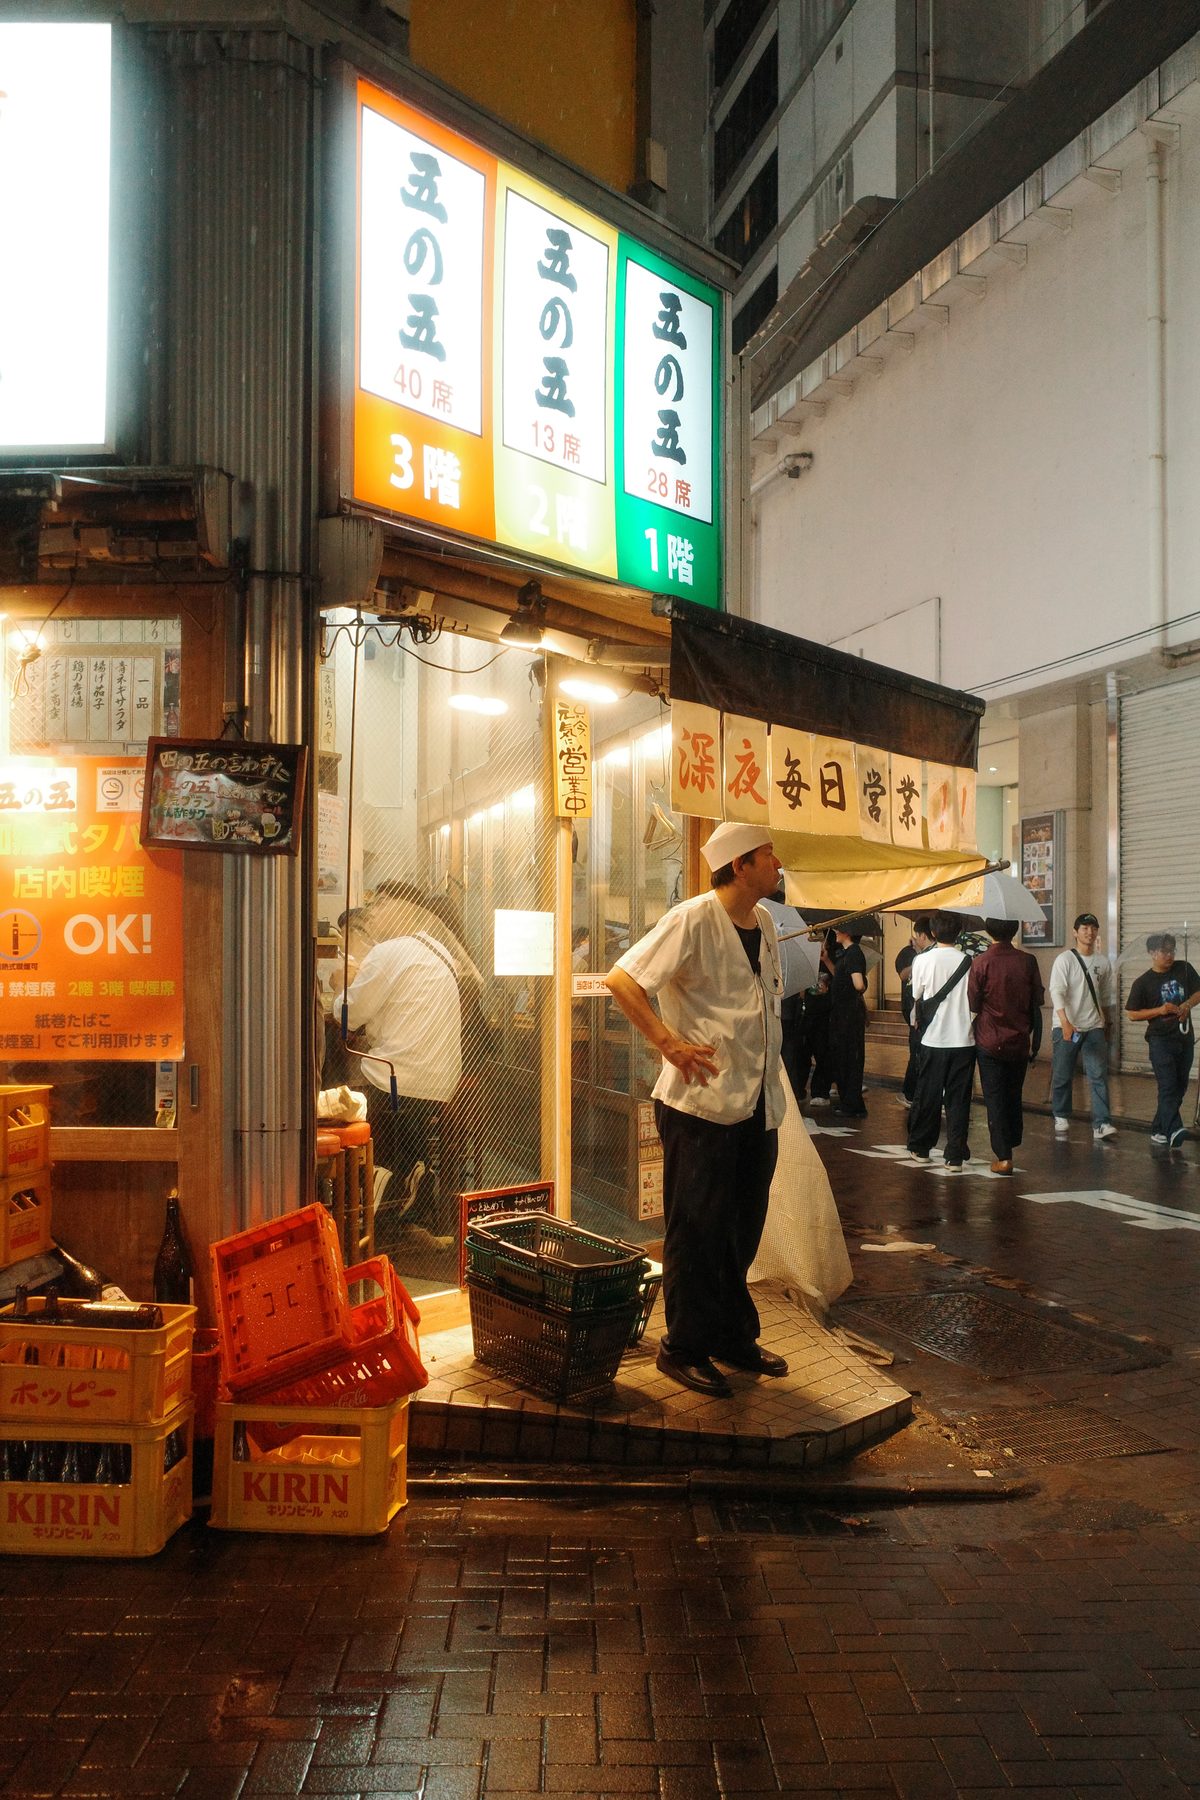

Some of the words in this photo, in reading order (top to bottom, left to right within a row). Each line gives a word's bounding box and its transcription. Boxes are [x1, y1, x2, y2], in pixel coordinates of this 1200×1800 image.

[400, 152, 448, 362] 五の五
[535, 228, 578, 418] 五の五
[651, 292, 687, 466] 五の五
[13, 866, 145, 898] 店内喫煙
[63, 914, 152, 955] OK!
[35, 1013, 112, 1029] 紙巻たばこ
[11, 1380, 117, 1408] ホッピー
[243, 1471, 349, 1504] KIRIN
[7, 1492, 121, 1527] KIRIN
[267, 1505, 323, 1518] キリンビール
[33, 1527, 93, 1540] キリンビール
